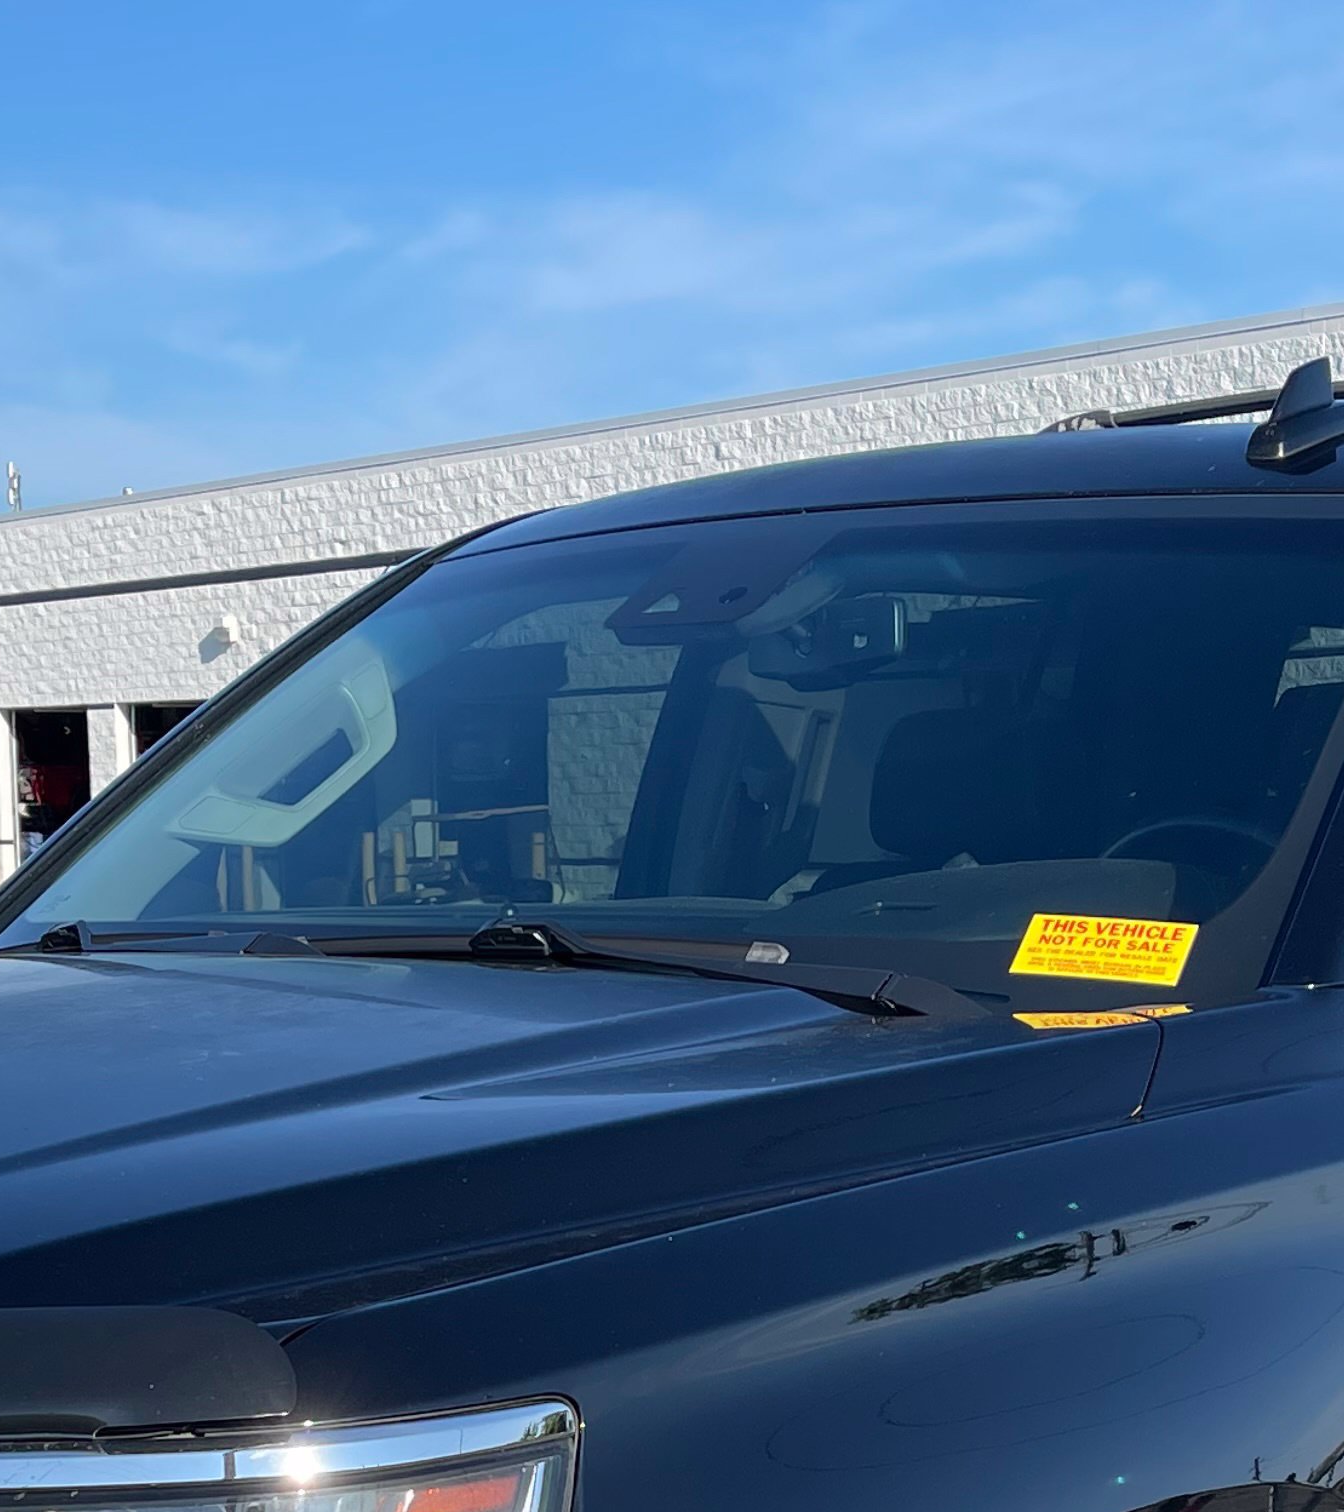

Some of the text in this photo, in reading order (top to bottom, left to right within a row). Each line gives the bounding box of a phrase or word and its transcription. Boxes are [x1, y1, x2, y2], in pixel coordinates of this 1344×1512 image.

[1041, 919, 1187, 941] THIS VEHICLE
[1039, 934, 1176, 954] NOT FOR SALE
